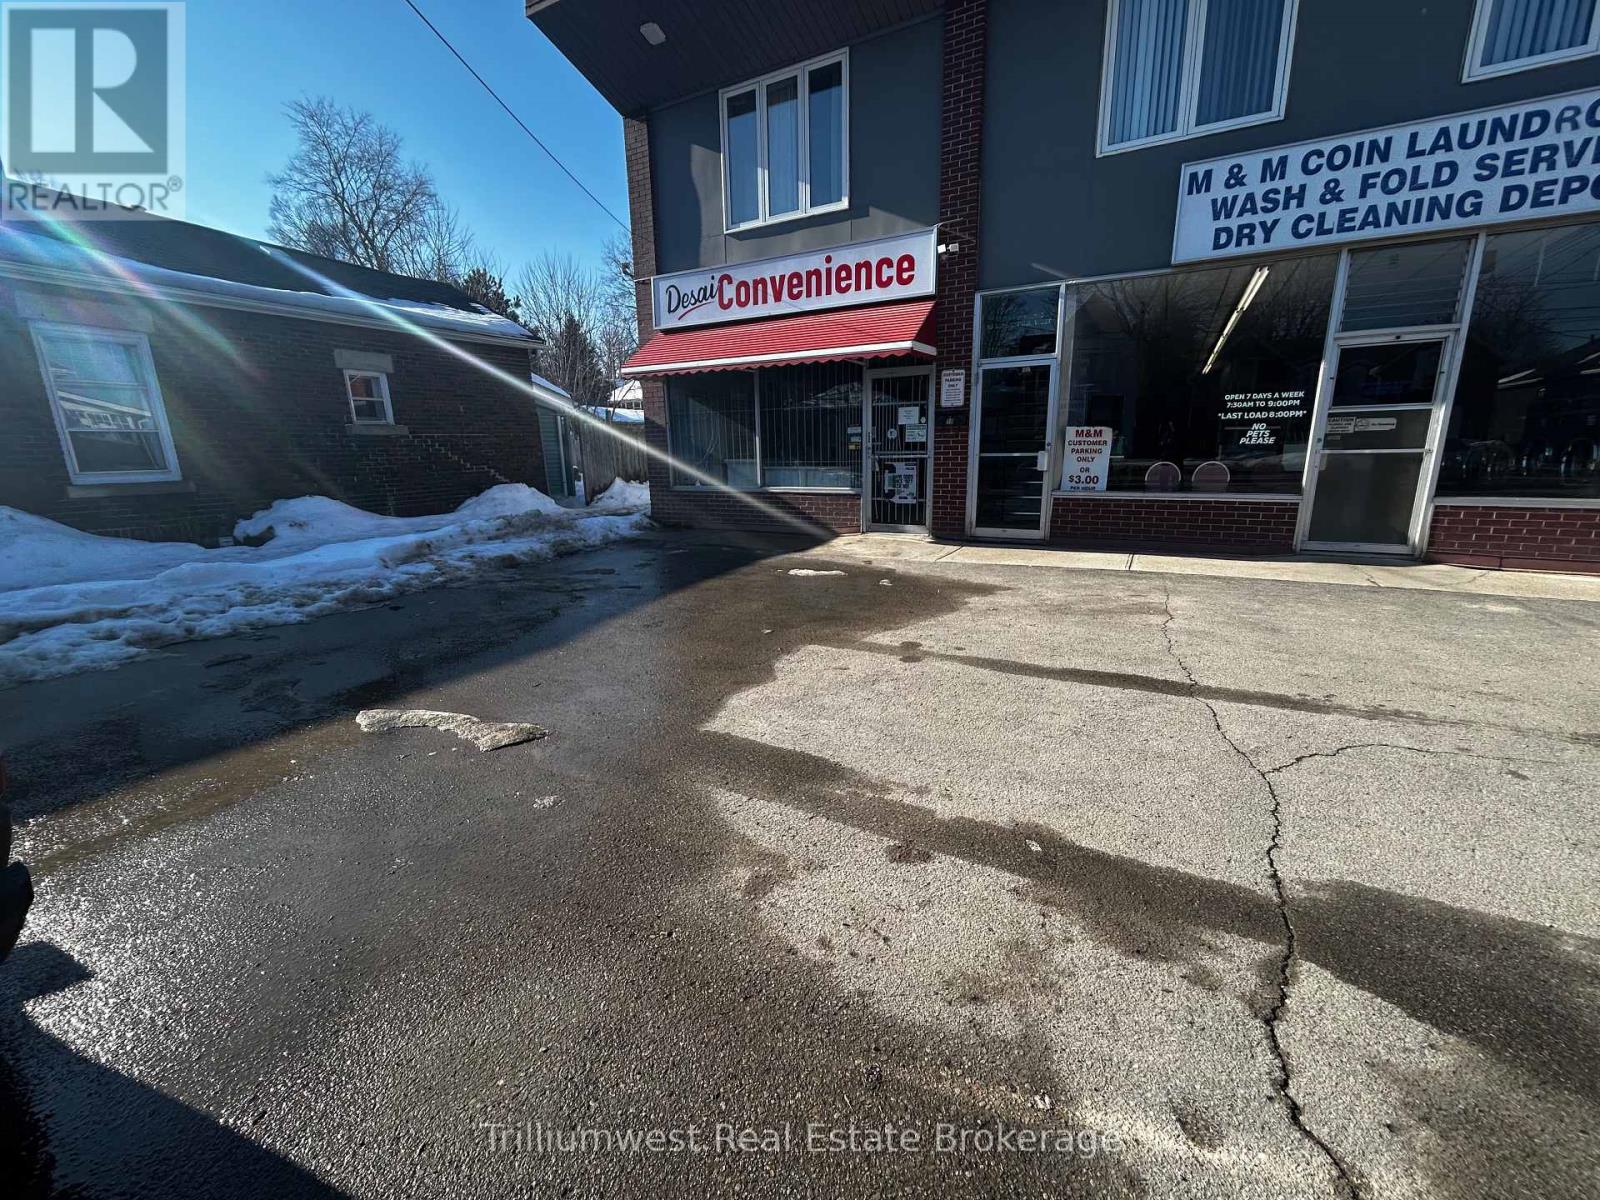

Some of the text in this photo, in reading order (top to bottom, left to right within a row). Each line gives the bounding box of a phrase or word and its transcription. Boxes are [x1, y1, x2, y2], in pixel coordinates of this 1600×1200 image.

[1187, 168, 1213, 196] M
[1224, 163, 1248, 190] &
[1260, 155, 1289, 184] M
[1301, 136, 1394, 176] COIN
[1211, 183, 1307, 221] WASH
[1319, 178, 1345, 205] &
[1359, 160, 1459, 199] FOLD
[1212, 218, 1280, 250] DRY
[1291, 190, 1484, 239] CLEANING
[666, 254, 916, 314] Desai Convenience
[1075, 429, 1103, 438] M&M
[1244, 411, 1268, 419] LOAD
[1069, 474, 1099, 485] $3.00
